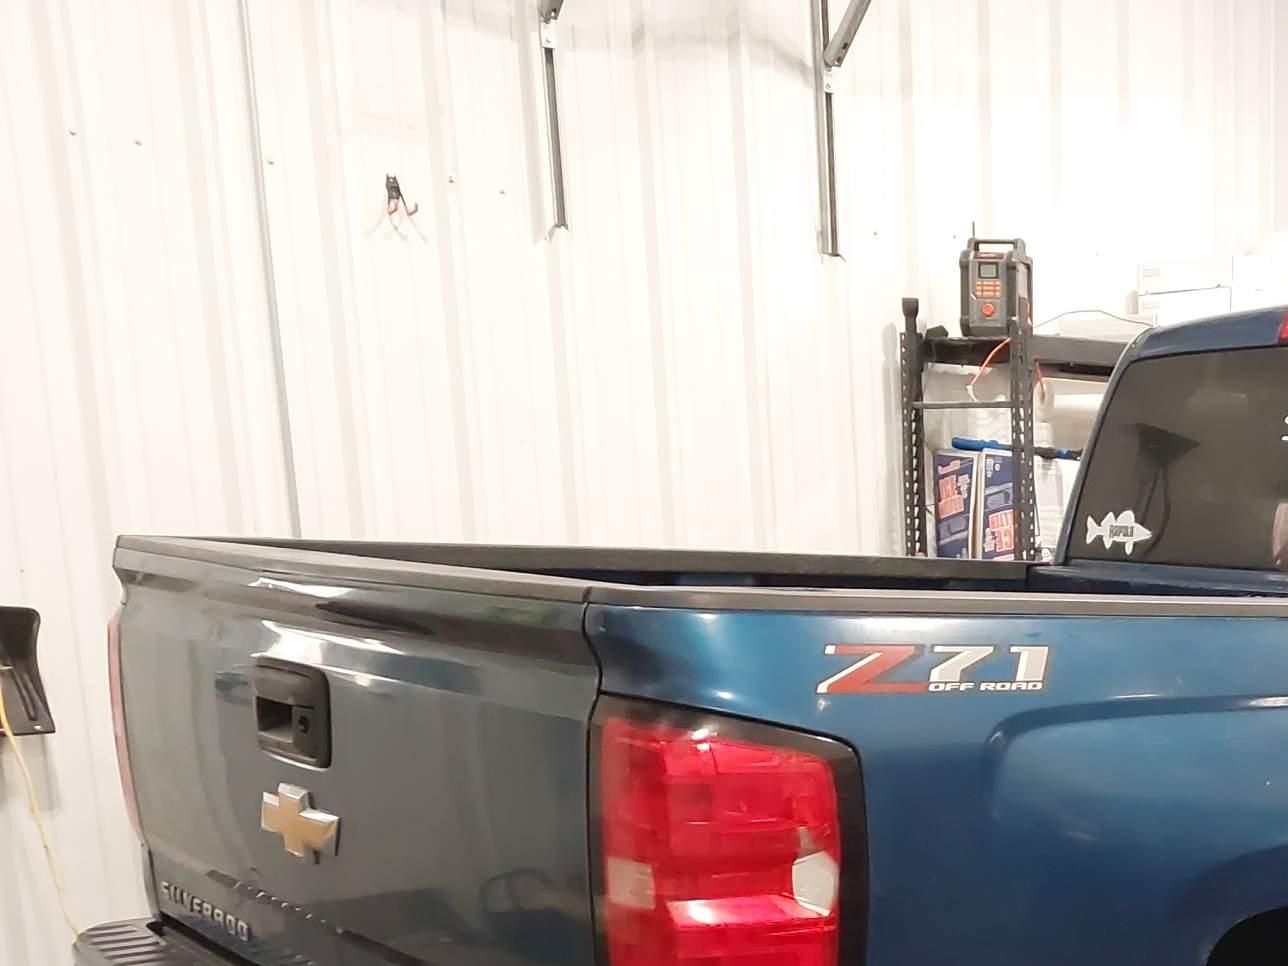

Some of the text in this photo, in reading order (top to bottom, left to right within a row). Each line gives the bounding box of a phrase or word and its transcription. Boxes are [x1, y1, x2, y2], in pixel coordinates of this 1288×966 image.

[816, 644, 1050, 693] Z71
[928, 681, 1044, 692] OFF ROAD
[160, 880, 250, 942] SILVERADO
